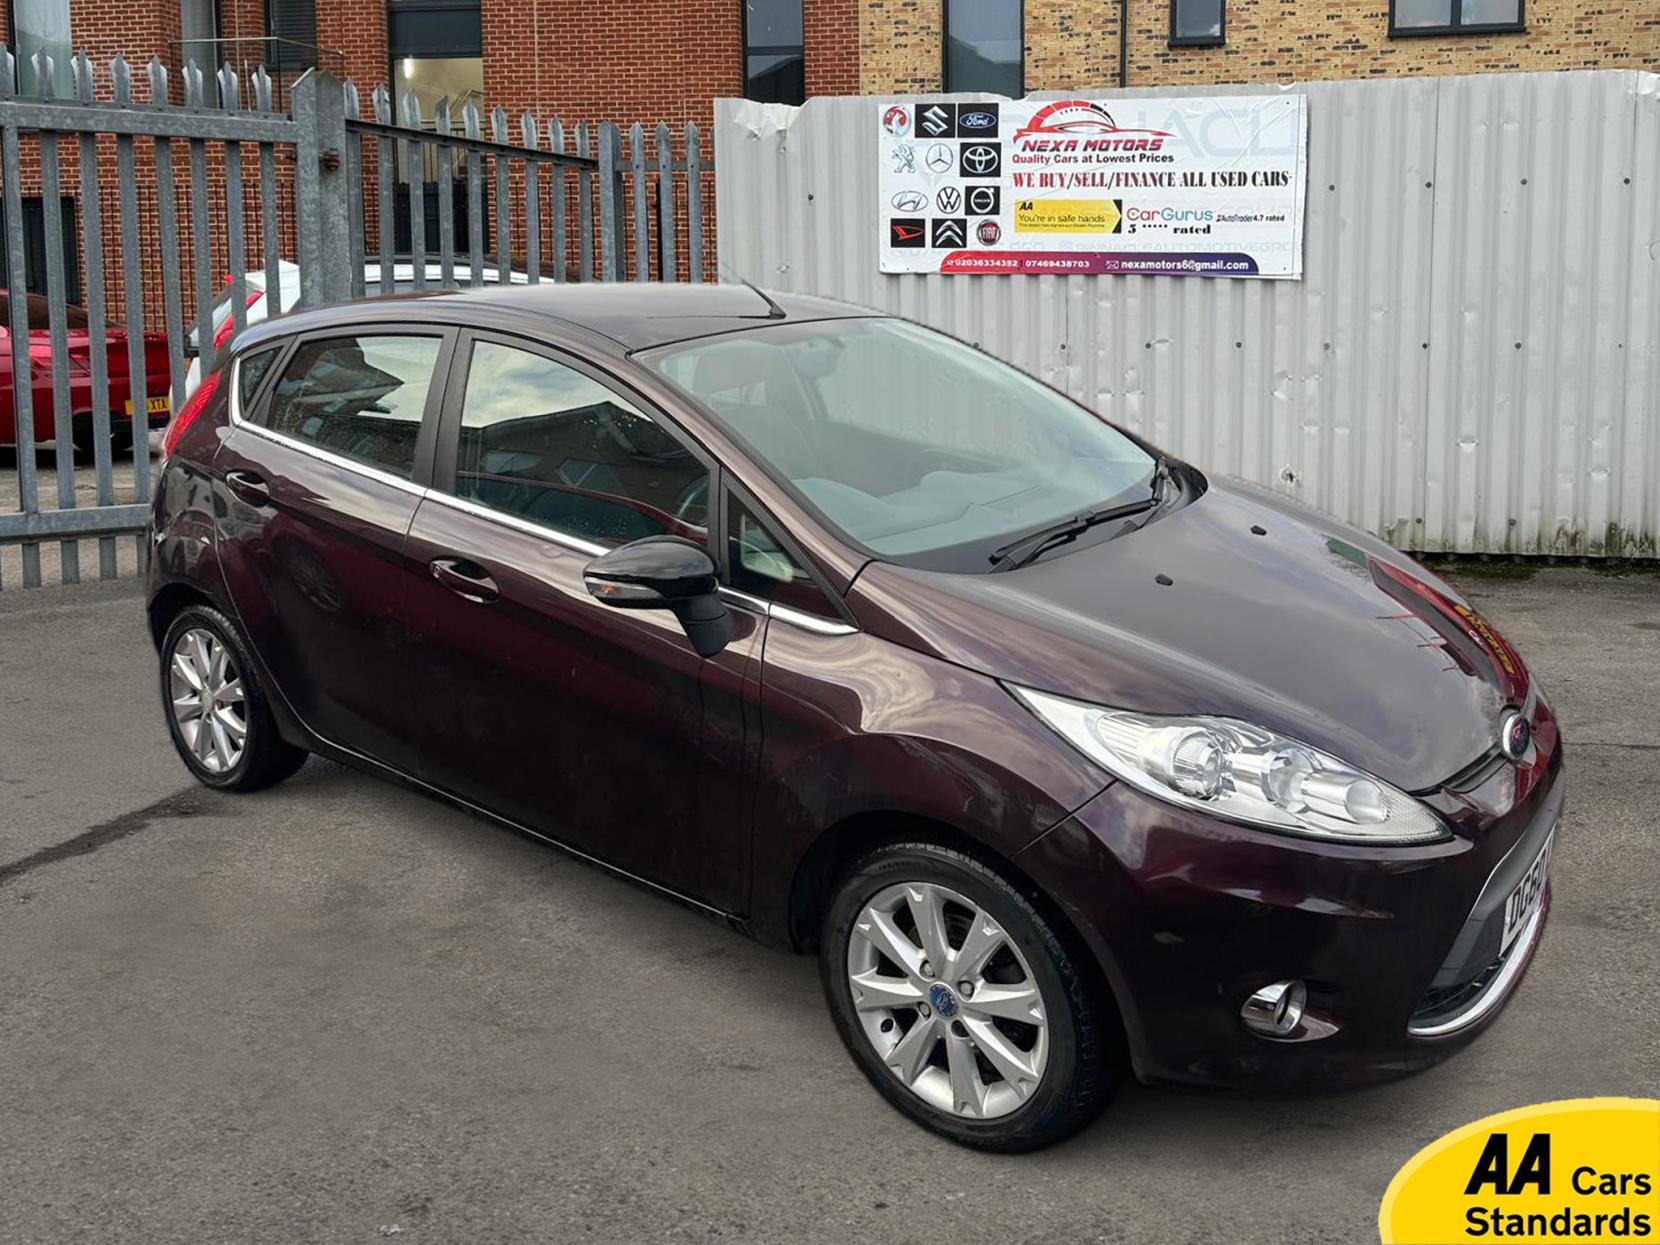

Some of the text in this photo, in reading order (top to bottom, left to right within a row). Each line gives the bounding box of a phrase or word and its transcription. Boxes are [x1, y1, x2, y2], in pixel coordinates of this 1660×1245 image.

[967, 115, 989, 126] Ford
[1021, 138, 1164, 152] NEXA MOTORS
[1012, 152, 1175, 166] Quality Cars at Lowest Prices
[1012, 172, 1035, 188] WE
[1039, 171, 1176, 190] BUY/SELL/FINANCE
[1179, 171, 1207, 188] ALL
[1210, 171, 1248, 188] USED
[1019, 202, 1034, 211] AA
[1018, 214, 1106, 223] You're in safe hands
[1126, 207, 1214, 221] CarGurus
[1265, 214, 1286, 222] rated
[1127, 224, 1212, 234] 5 rated
